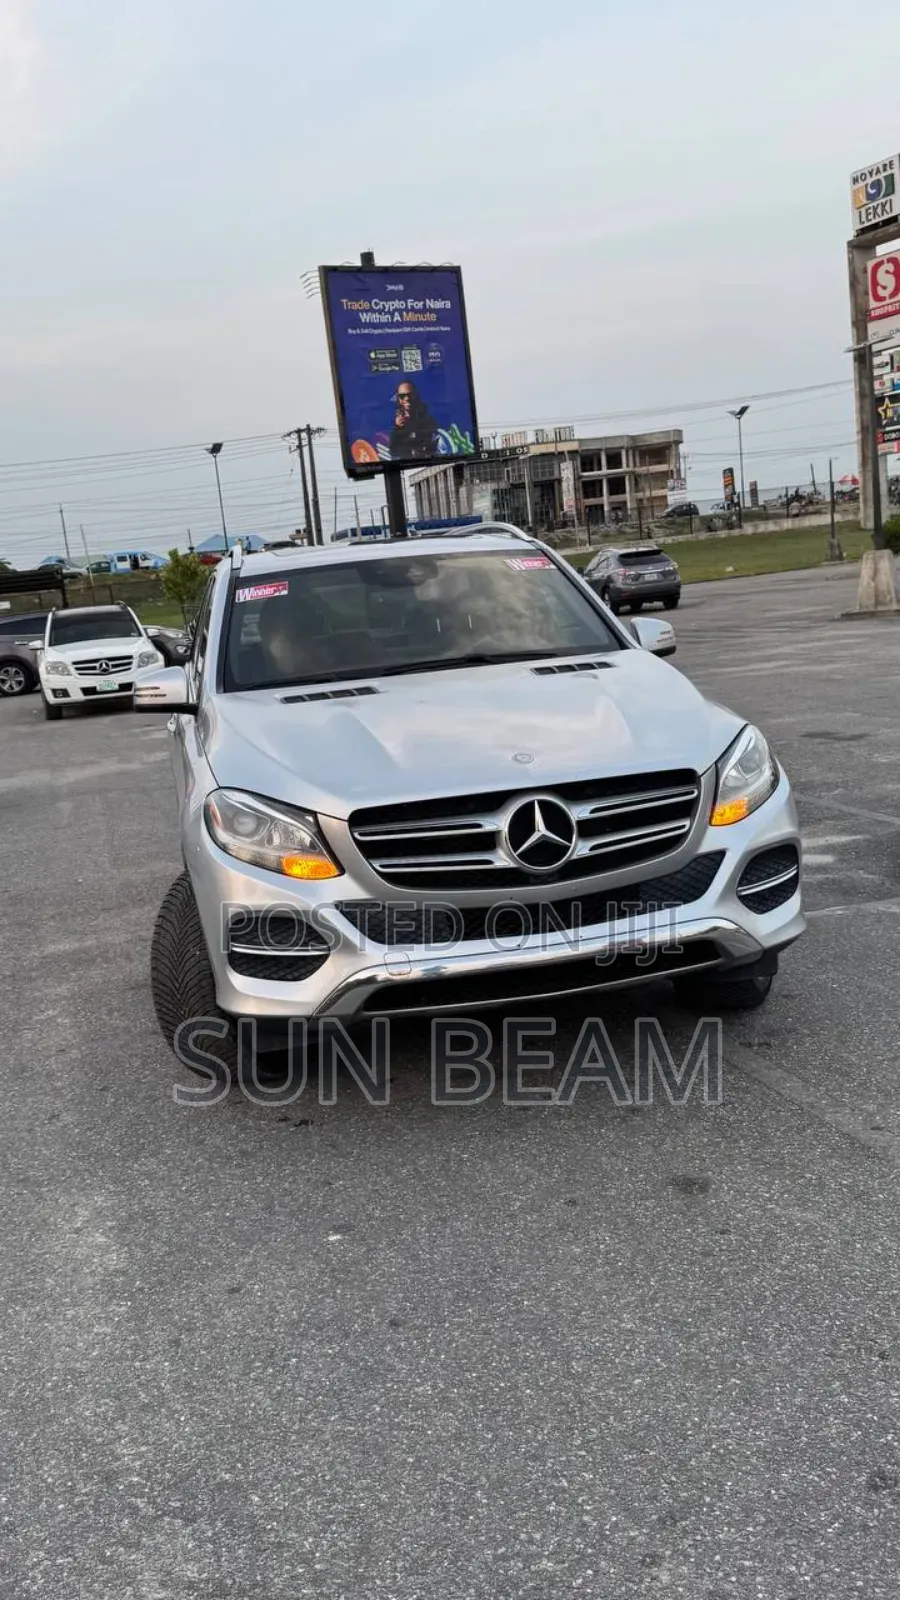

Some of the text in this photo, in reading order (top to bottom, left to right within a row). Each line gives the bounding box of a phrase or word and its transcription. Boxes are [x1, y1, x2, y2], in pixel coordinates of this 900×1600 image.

[852, 160, 895, 186] NOVARE
[858, 198, 893, 225] LEKKI
[341, 298, 451, 312] Trade Crypto For Naira
[359, 312, 437, 323] Within A Minute
